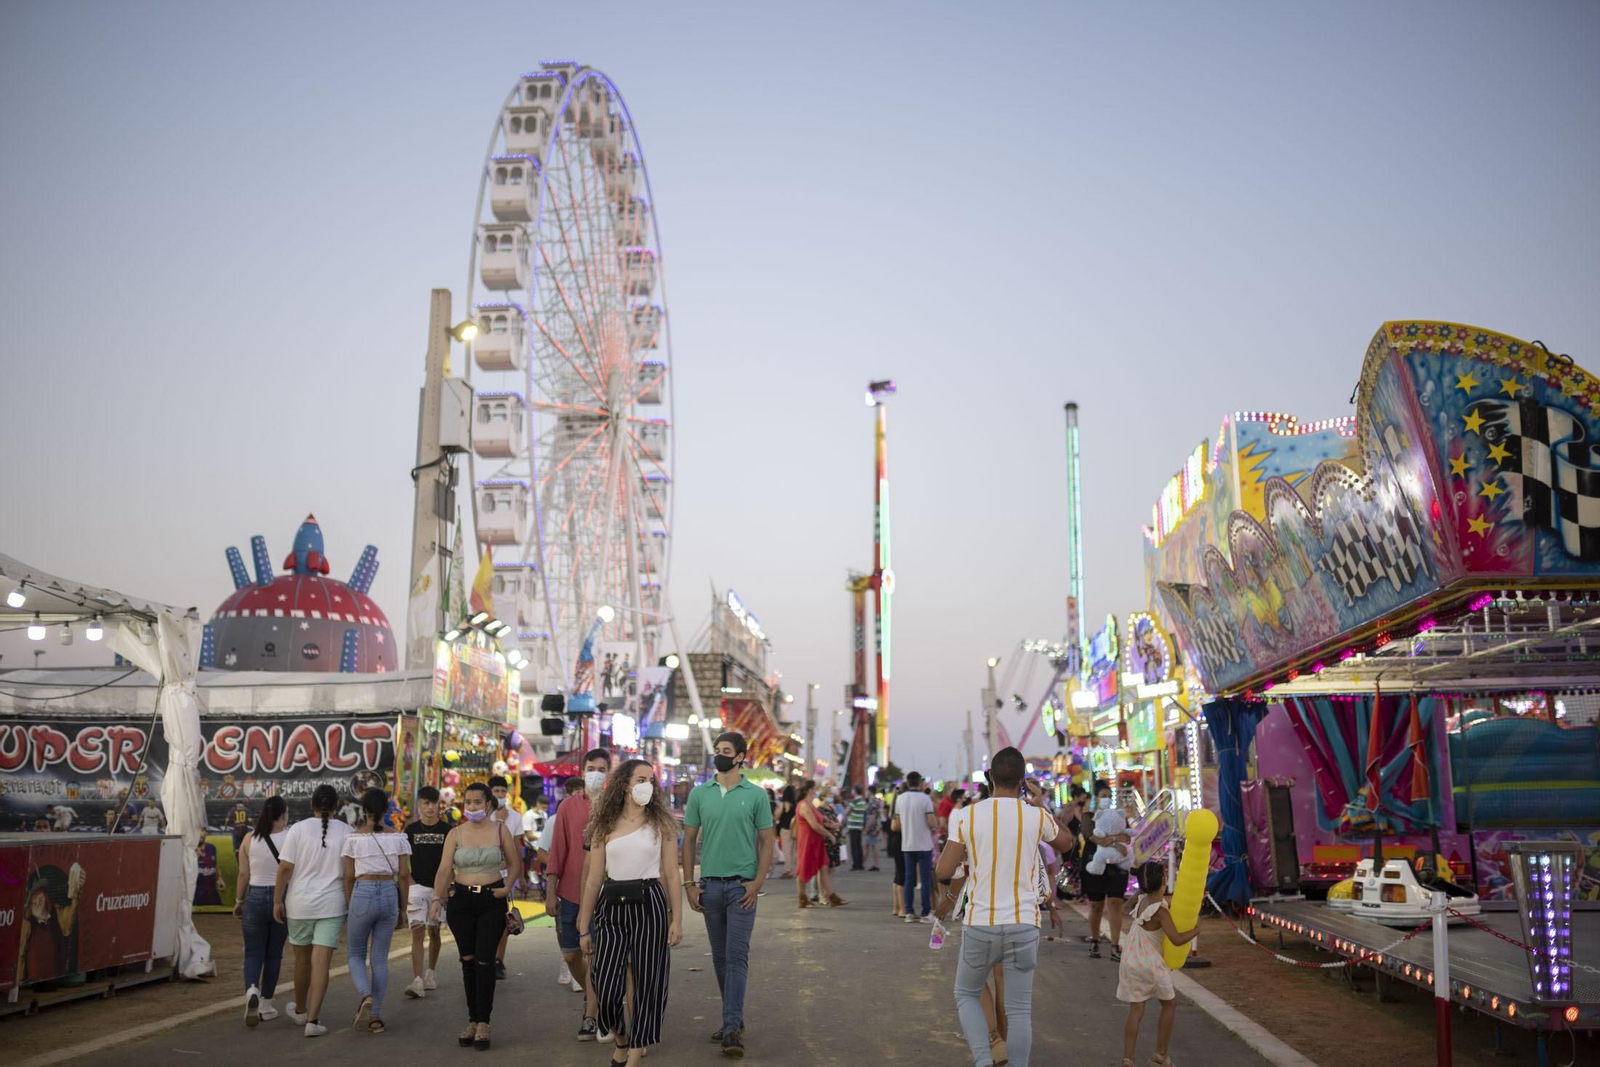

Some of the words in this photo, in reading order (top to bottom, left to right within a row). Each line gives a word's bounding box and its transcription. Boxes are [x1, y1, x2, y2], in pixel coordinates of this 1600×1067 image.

[200, 722, 398, 774] ENALT
[235, 811, 246, 824] 10
[96, 891, 149, 912] Cruzcampo
